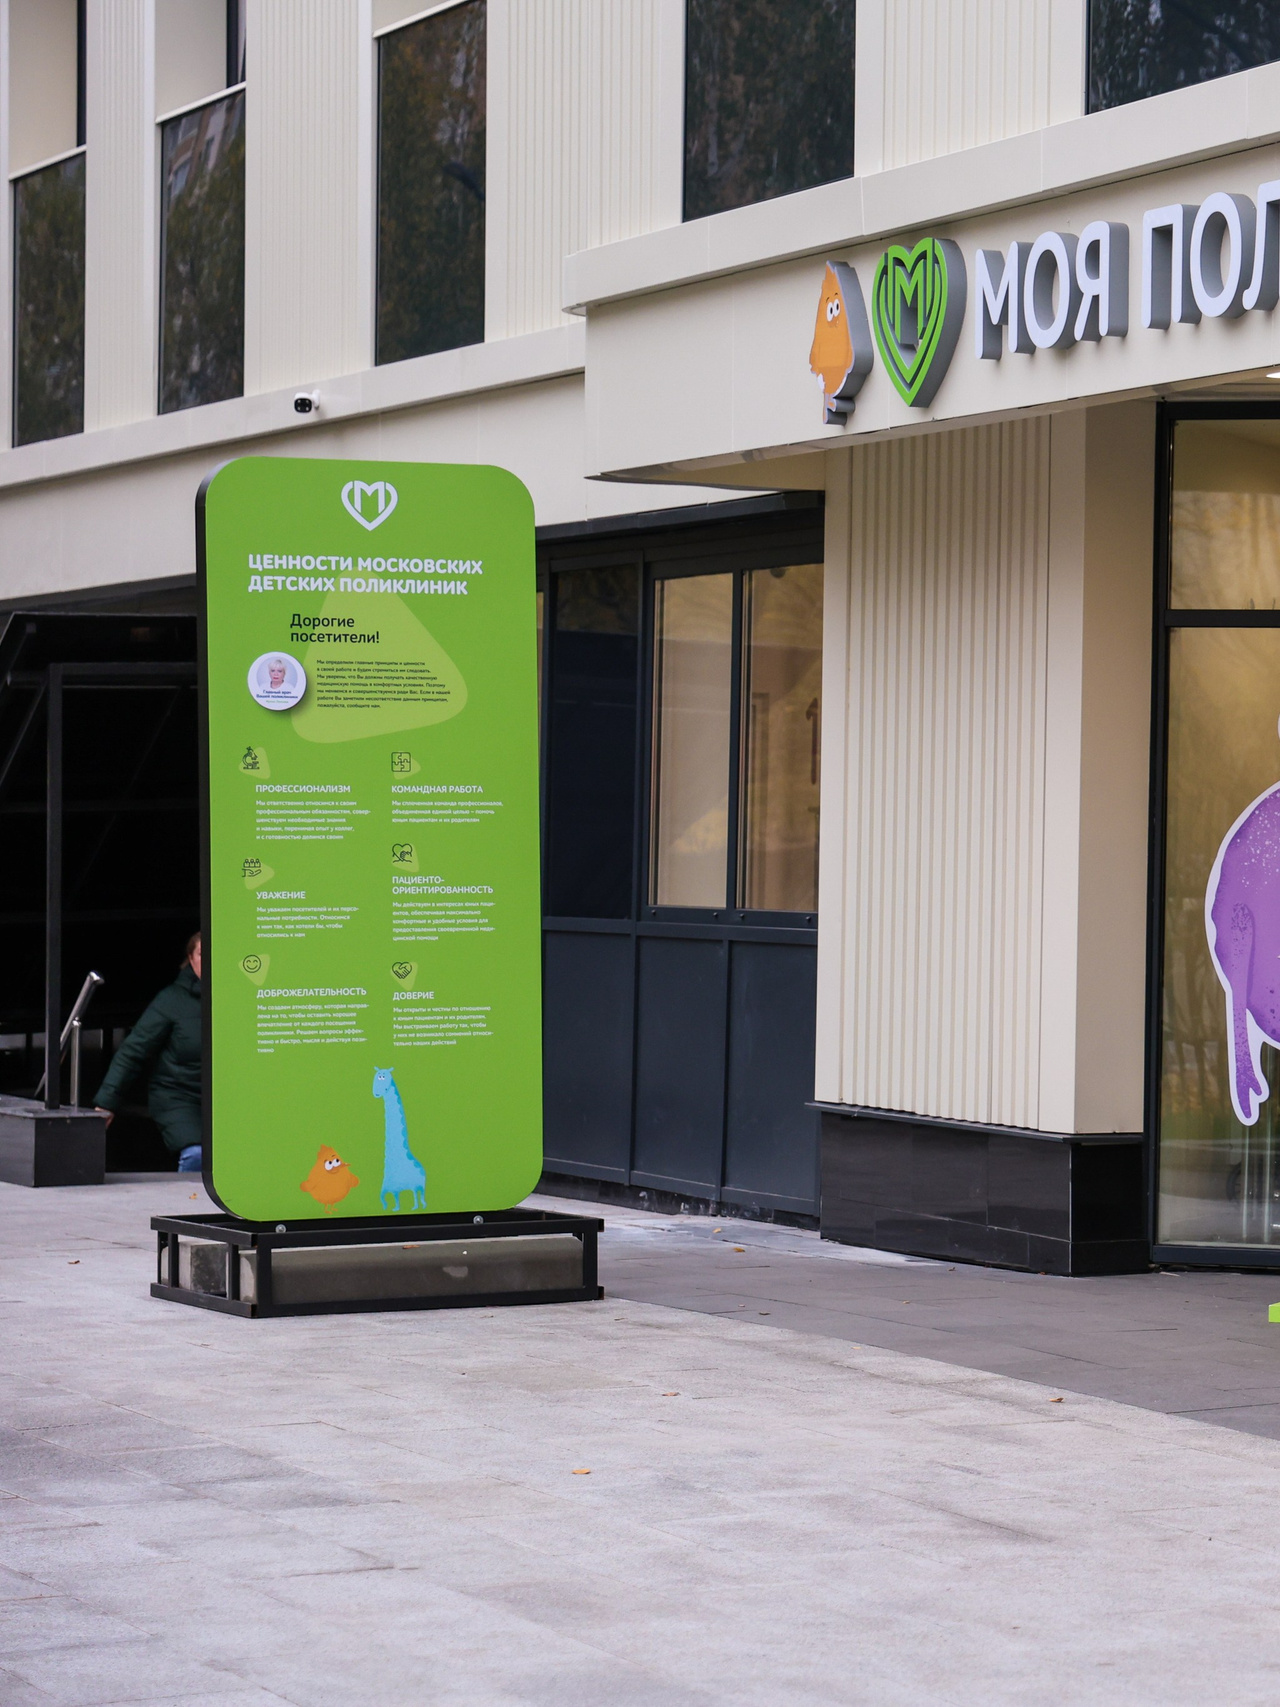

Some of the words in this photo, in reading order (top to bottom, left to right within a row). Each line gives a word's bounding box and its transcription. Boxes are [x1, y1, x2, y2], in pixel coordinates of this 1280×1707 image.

[975, 220, 1112, 360] МОЯ
[248, 554, 353, 571] ЦЕННОСТИ
[357, 557, 483, 575] МОСКОВСКИХ
[247, 575, 335, 593] ДЕТСКИХ
[339, 578, 468, 595] ПОЛИКЛИНИК
[290, 613, 355, 630] Дорогие
[290, 631, 380, 643] посетители!
[255, 785, 351, 793] ПРОФЕССИОНАЛИЗМ
[391, 785, 447, 794] КОМАНДНАЯ
[449, 785, 483, 793] РАБОТА
[392, 876, 445, 885] ПАЦИЕНТО-
[256, 891, 306, 899] УВАЖЕНИЕ
[392, 886, 494, 894] ОРИЕНТИРОВАННОСТЬ
[257, 987, 367, 998] ДОБРОЖЕЛАТЕЛЬНОСТЬ
[393, 991, 434, 1000] ДОВЕРИЕ
